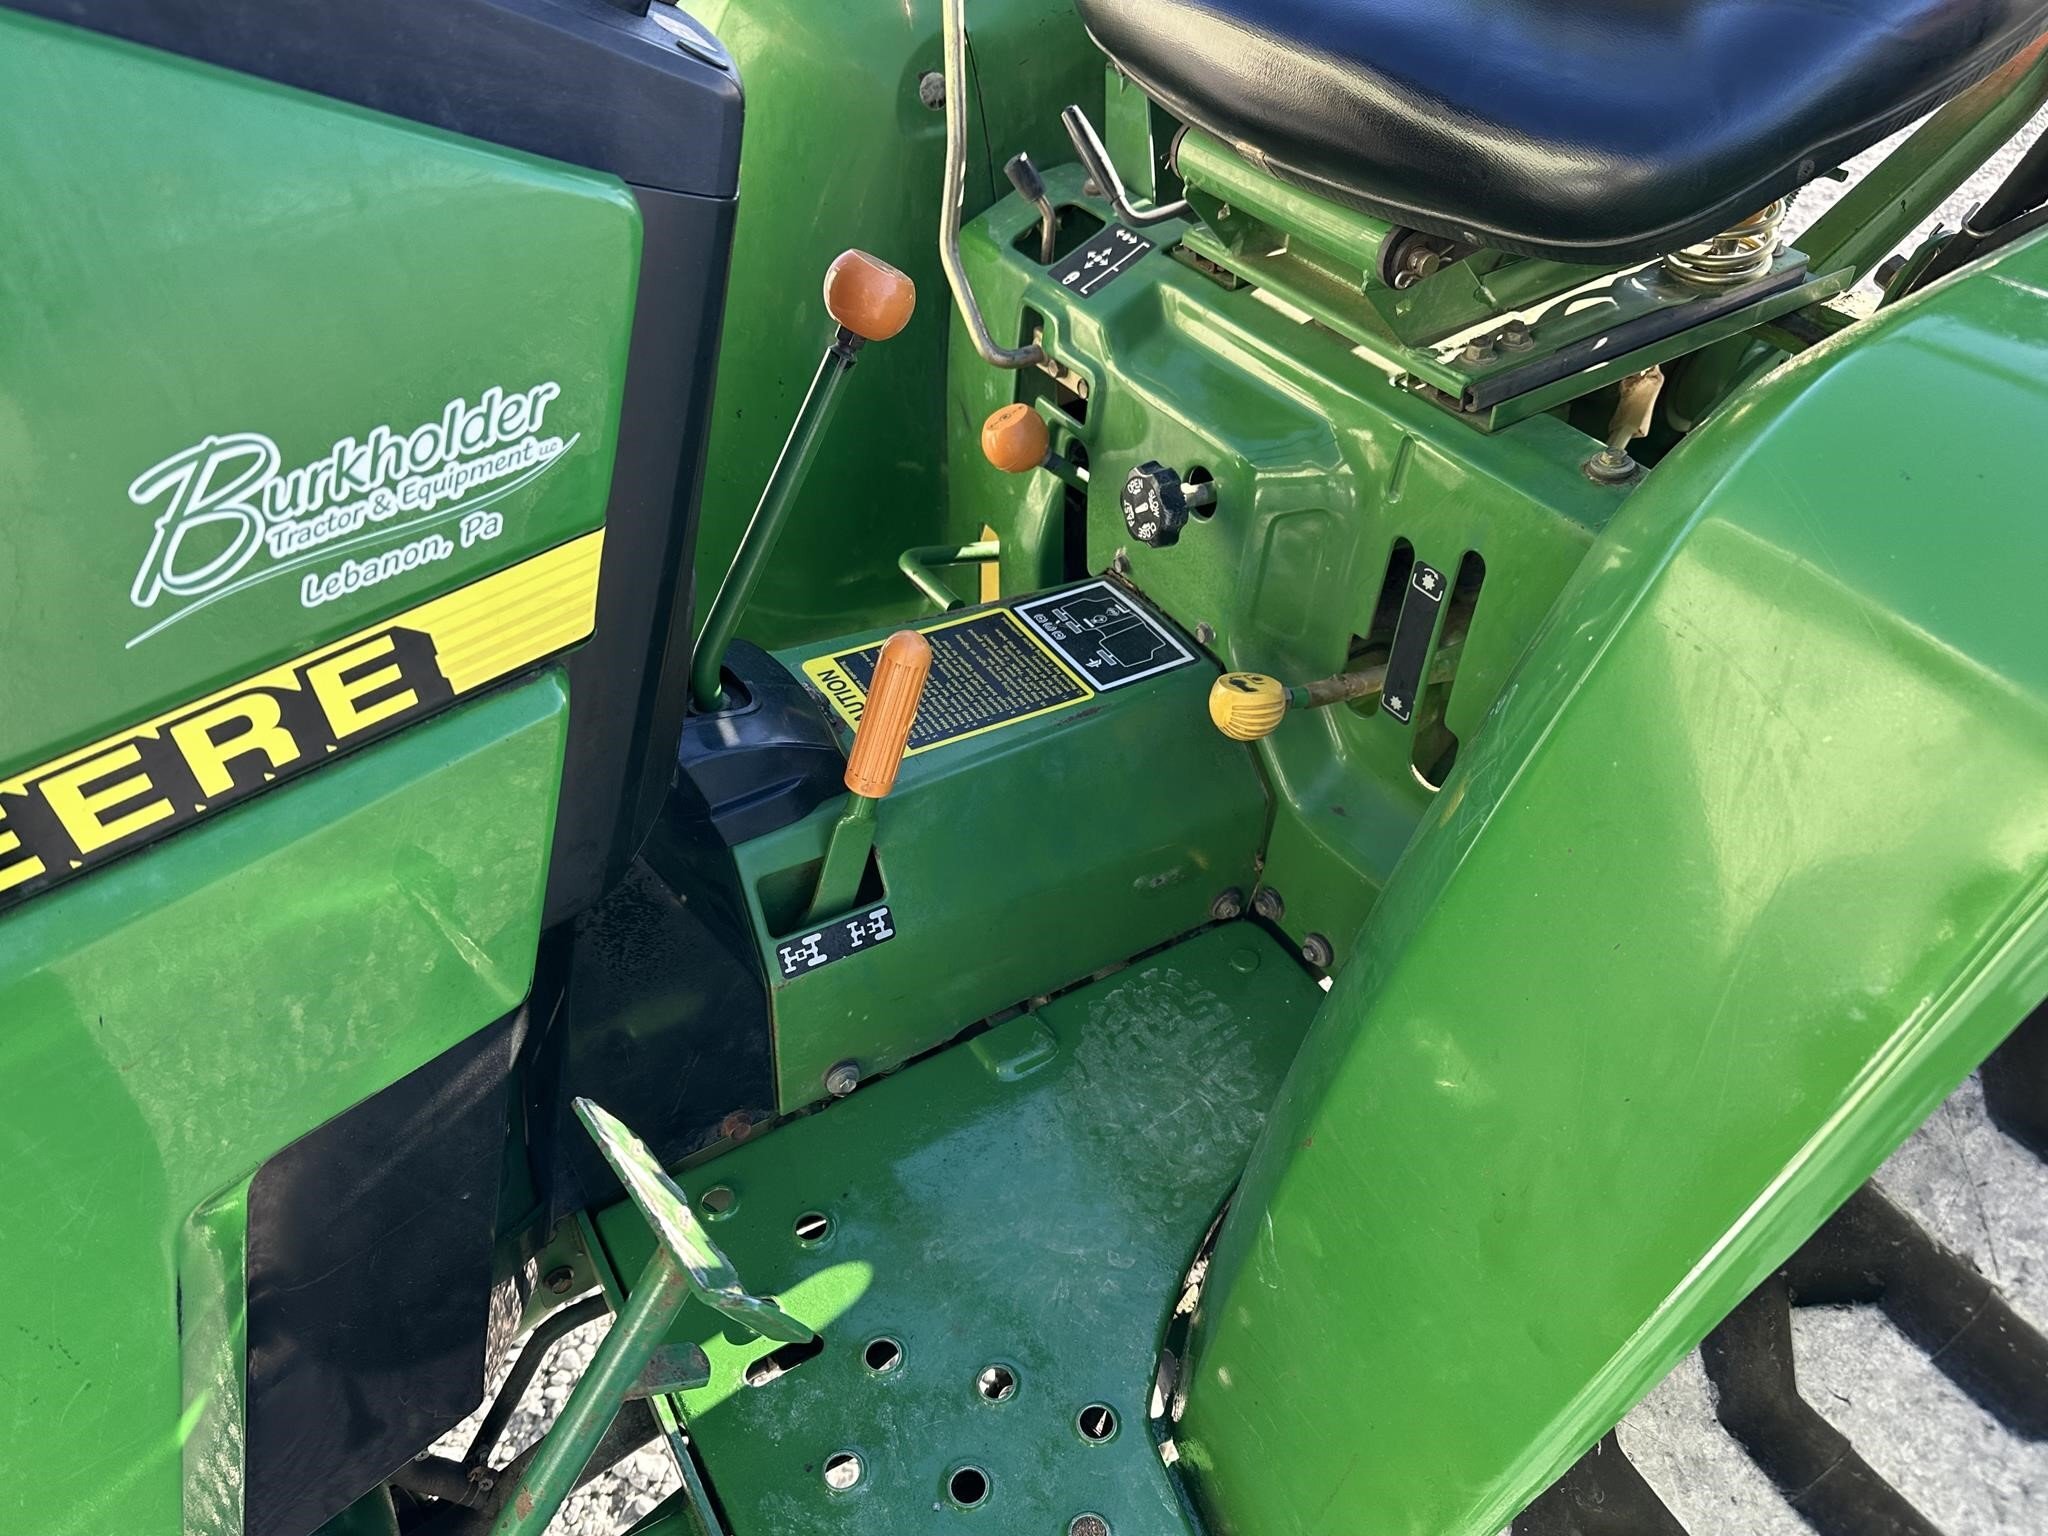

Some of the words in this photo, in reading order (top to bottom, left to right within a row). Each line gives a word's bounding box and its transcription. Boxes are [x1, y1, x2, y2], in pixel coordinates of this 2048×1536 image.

[129, 382, 560, 607] Burkholder
[265, 503, 373, 557] Tractor
[372, 489, 396, 520] &
[400, 441, 537, 506] Equipment
[301, 534, 454, 608] Lebanon,
[459, 511, 503, 551] Pa
[818, 669, 866, 722] UTION
